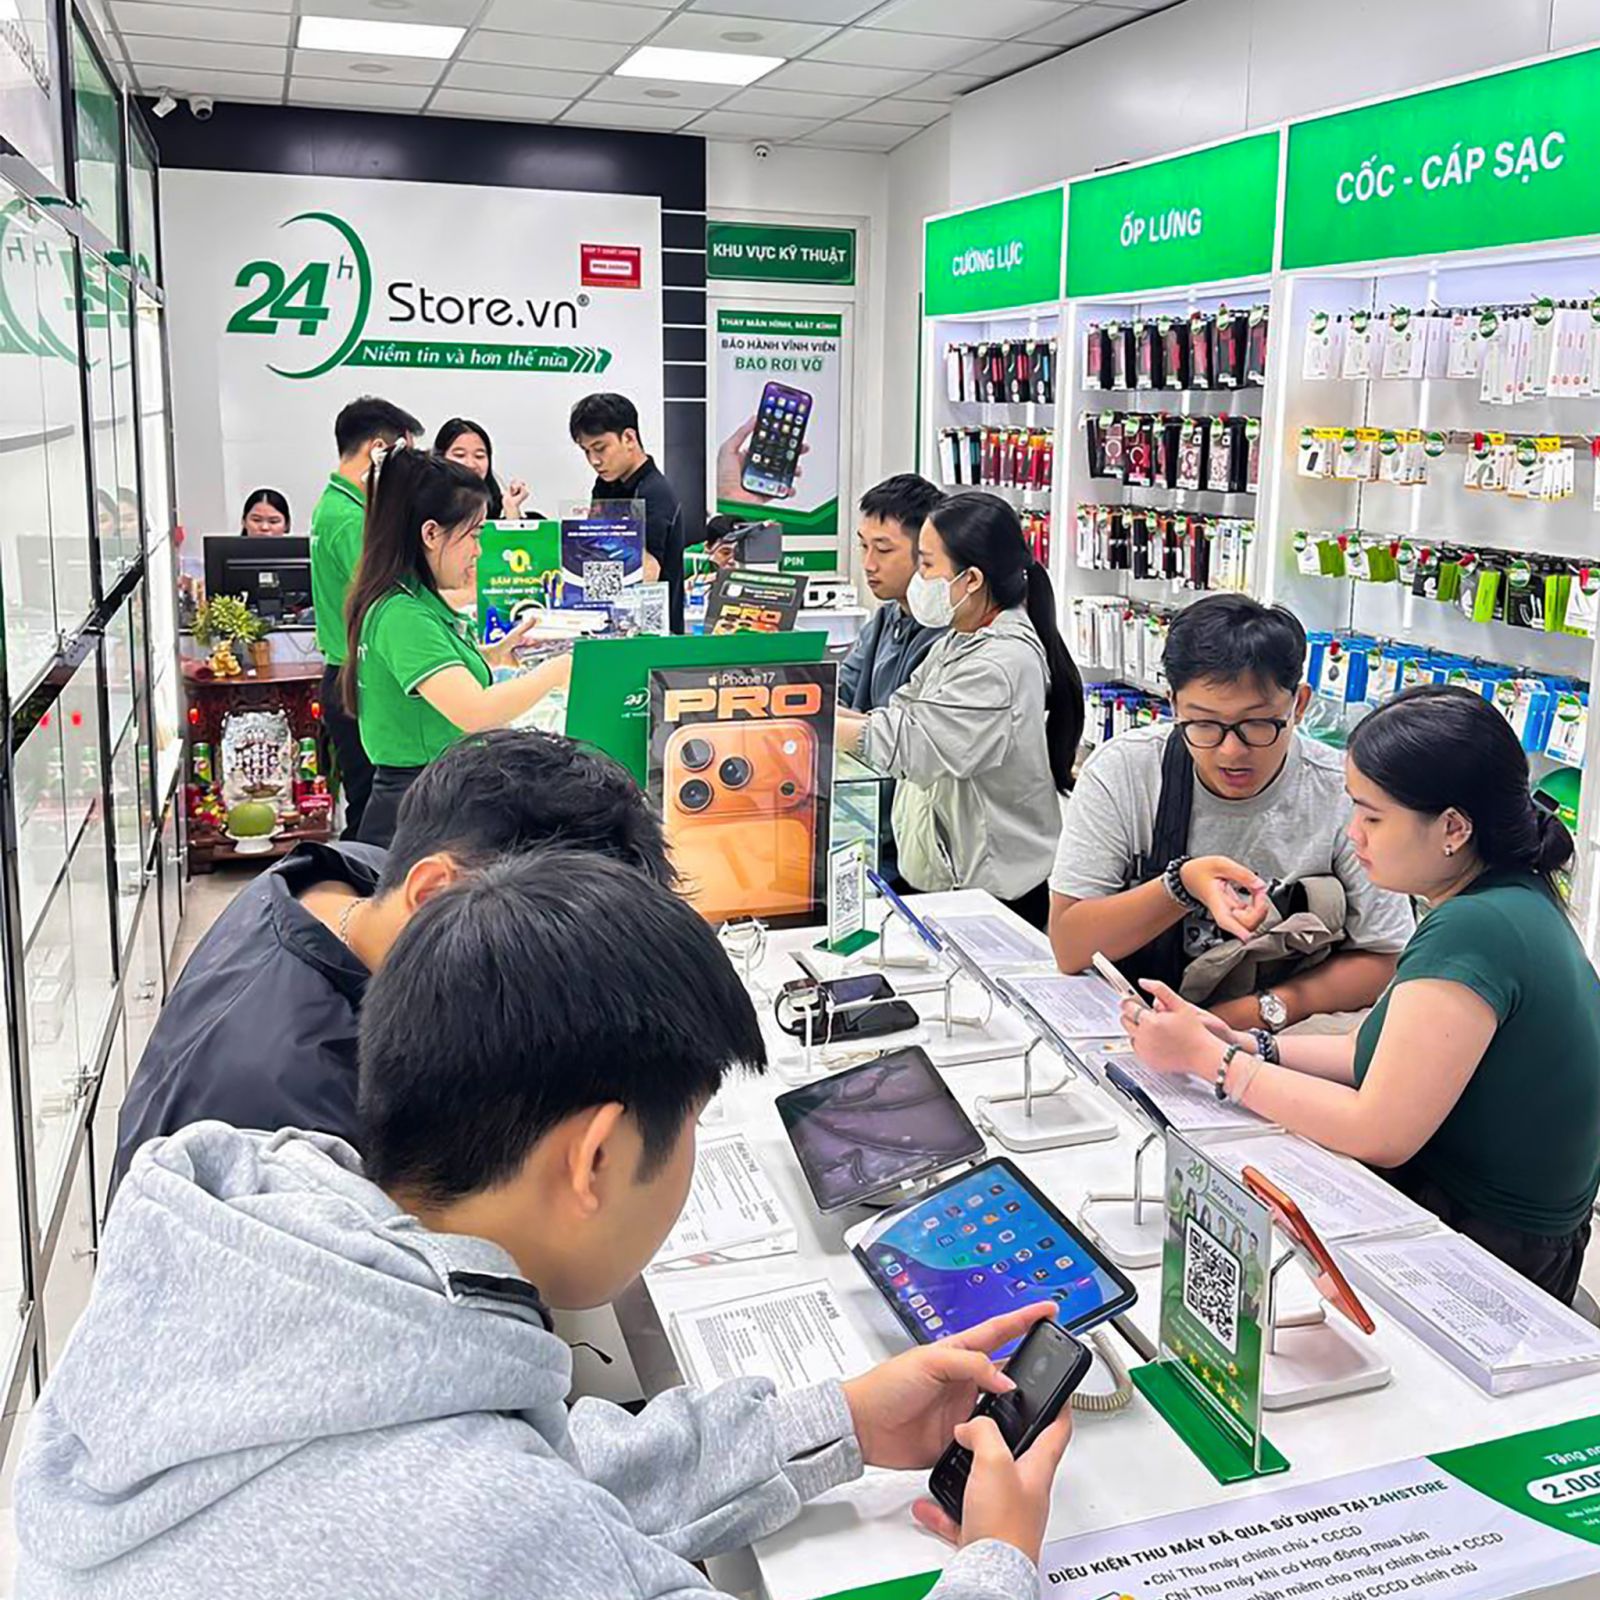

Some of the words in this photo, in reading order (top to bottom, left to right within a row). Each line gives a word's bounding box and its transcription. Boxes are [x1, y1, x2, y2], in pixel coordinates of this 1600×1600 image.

[1336, 154, 1395, 204] CỐC
[1421, 141, 1486, 190] CÁP
[1493, 131, 1565, 184] SẠC
[1120, 210, 1146, 247] ỐP
[713, 243, 743, 258] KHU
[746, 245, 777, 262] VỰC
[779, 244, 798, 260] KỸ
[800, 246, 847, 265] THUẬT
[362, 342, 411, 363] Niềm
[417, 346, 440, 363] tin
[446, 347, 465, 365] và
[470, 350, 501, 366] hơn
[507, 348, 534, 367] thế
[735, 357, 767, 370] BAO
[783, 556, 804, 566] PIN
[720, 604, 782, 624] PRO
[664, 683, 822, 722] PRO
[1089, 1554, 1131, 1574] KIỆN
[1131, 1547, 1168, 1565] THU
[1168, 1536, 1207, 1556] MÁY
[1207, 1529, 1233, 1547] ĐÃ
[1234, 1523, 1271, 1541] QUA
[1295, 1504, 1341, 1525] DỤNG
[1343, 1498, 1369, 1514] TẠI
[1368, 1479, 1449, 1507] 24HSTORE
[1176, 1565, 1208, 1579] Thu
[1208, 1557, 1240, 1571] máy
[1242, 1544, 1282, 1563] chính
[1321, 1525, 1362, 1544] CCCD
[1191, 1582, 1222, 1597] Thu
[1223, 1574, 1255, 1589] máy
[1281, 1561, 1300, 1575] có
[1370, 1537, 1402, 1553] mua
[1400, 1528, 1430, 1545] bán
[1324, 1572, 1353, 1586] cho
[1353, 1563, 1385, 1579] máy
[1385, 1552, 1425, 1571] chính
[1462, 1531, 1504, 1551] CCCD
[1365, 1579, 1410, 1599] CCCD
[1410, 1569, 1451, 1588] chính
